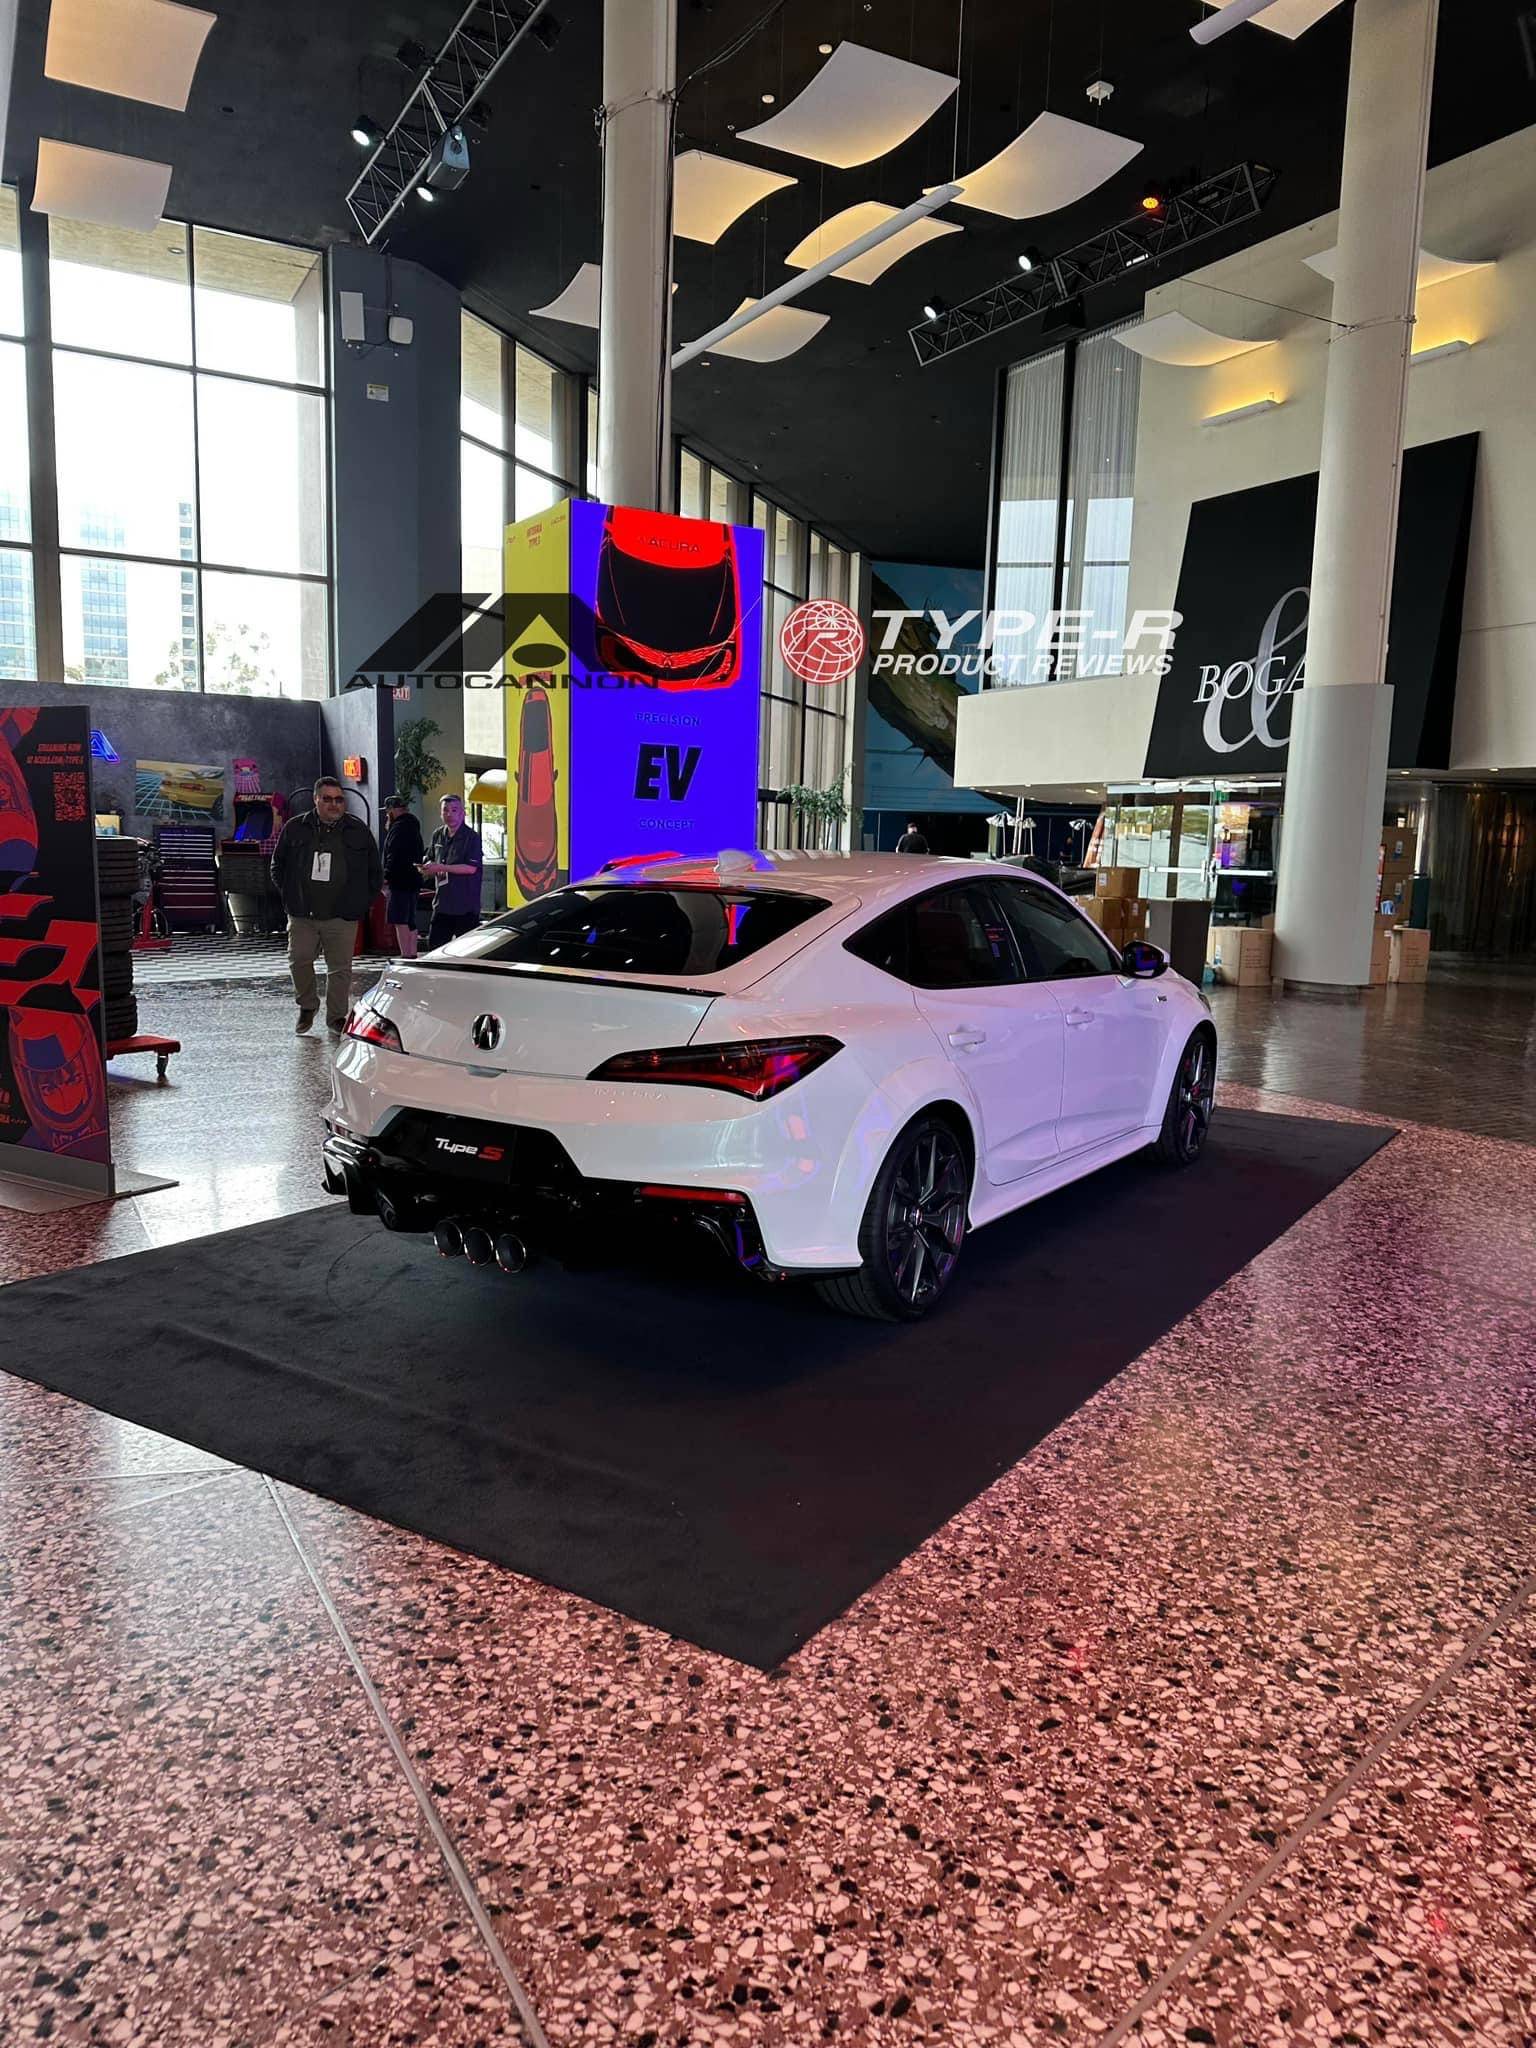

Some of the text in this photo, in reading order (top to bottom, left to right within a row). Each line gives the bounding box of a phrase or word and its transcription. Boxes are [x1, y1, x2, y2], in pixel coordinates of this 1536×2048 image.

[648, 536, 703, 553] ACURA
[636, 712, 702, 727] PRECISION
[633, 742, 703, 802] EV
[639, 818, 695, 831] CONCEPT
[435, 1137, 504, 1161] Type S
